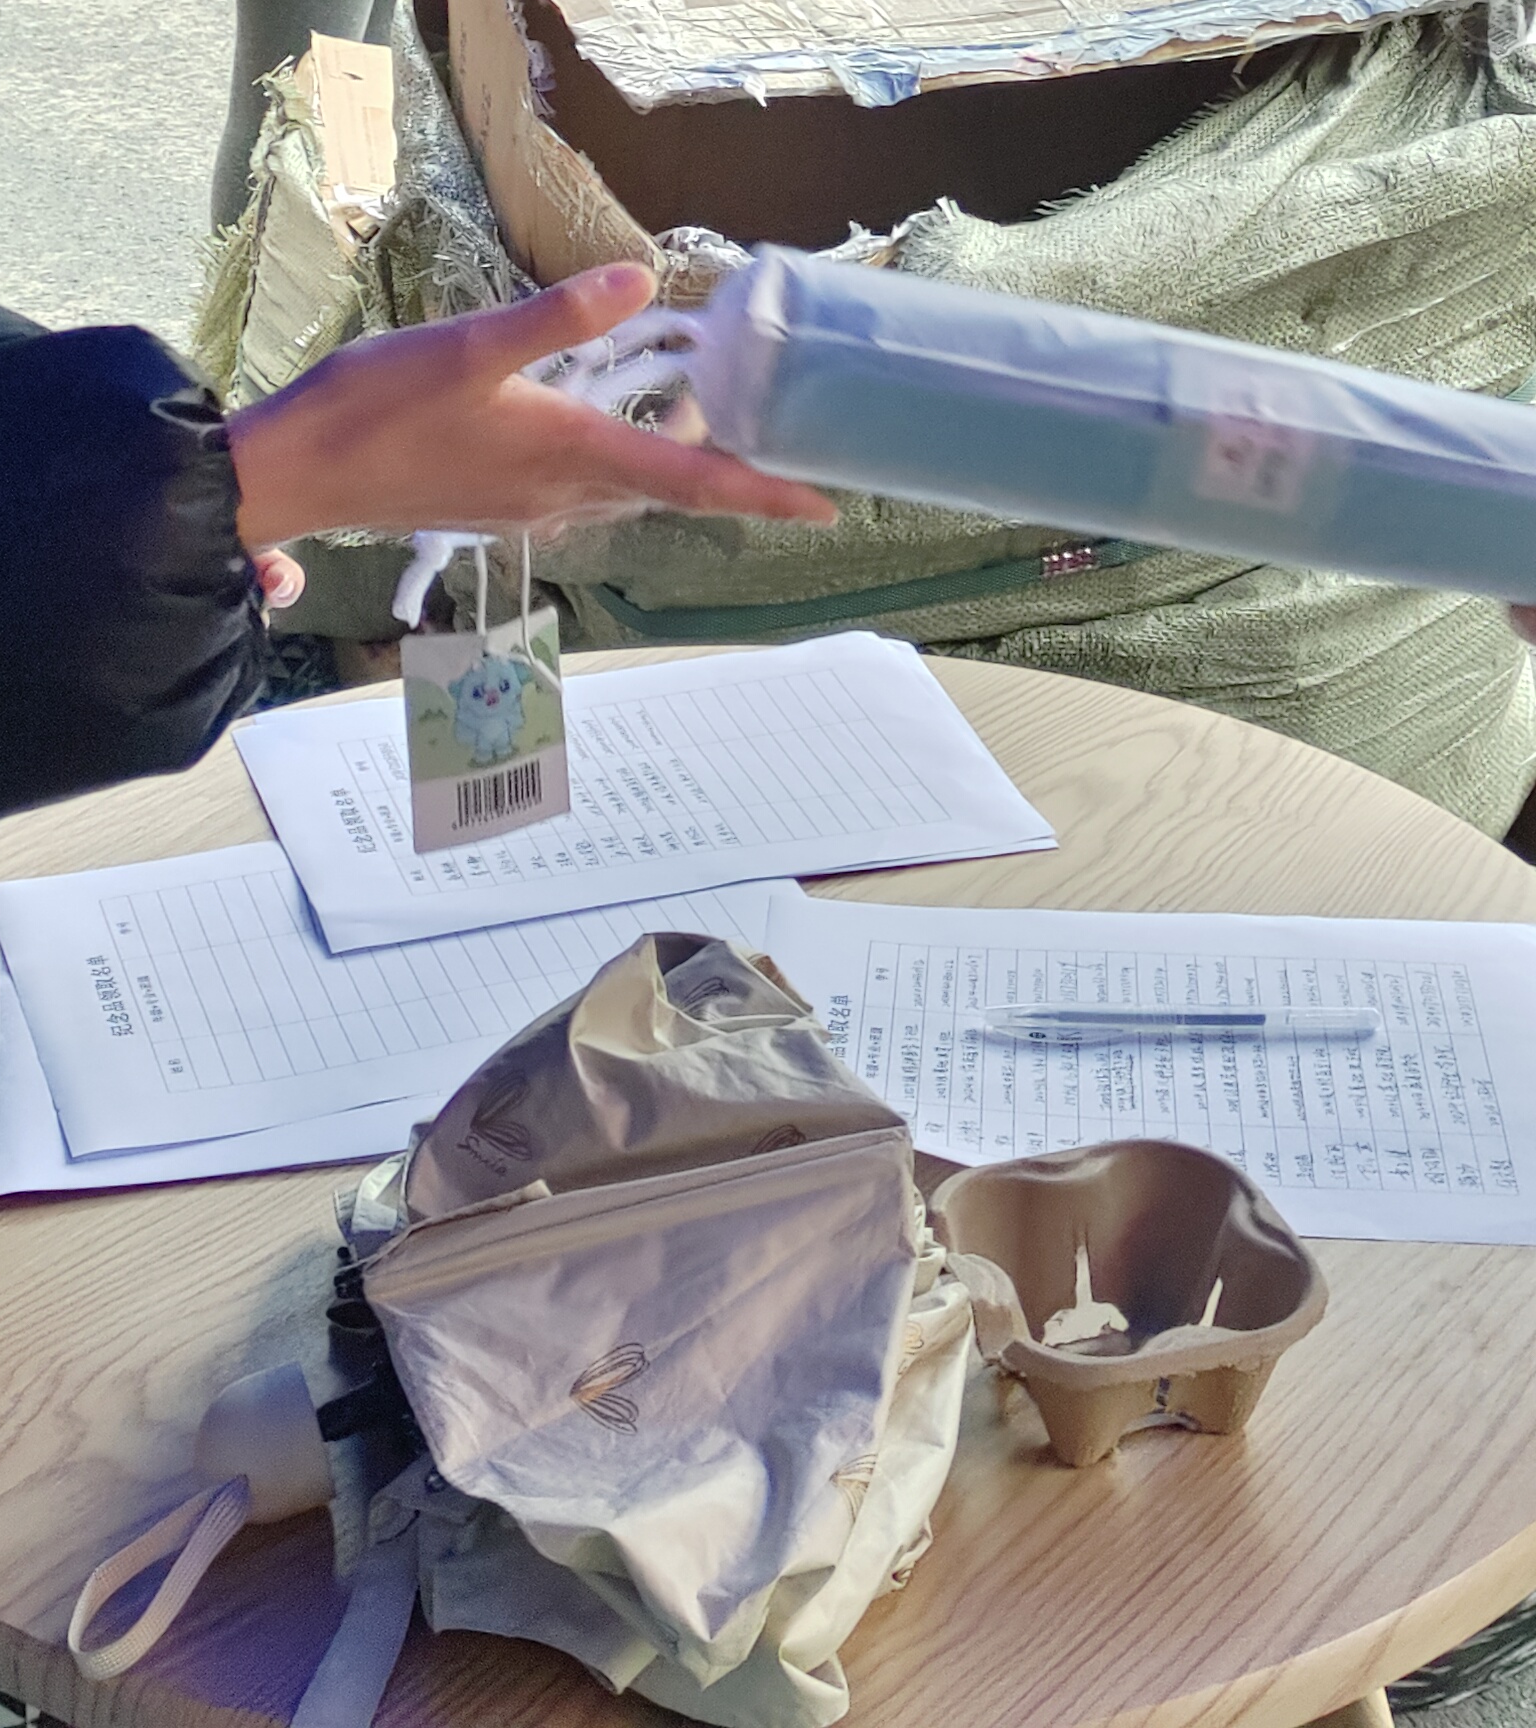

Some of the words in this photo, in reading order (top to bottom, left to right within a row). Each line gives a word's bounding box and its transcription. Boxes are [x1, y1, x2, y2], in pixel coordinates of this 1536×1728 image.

[330, 788, 378, 854] 纪念品领取名单
[84, 954, 135, 1037] 纪念品领取名单
